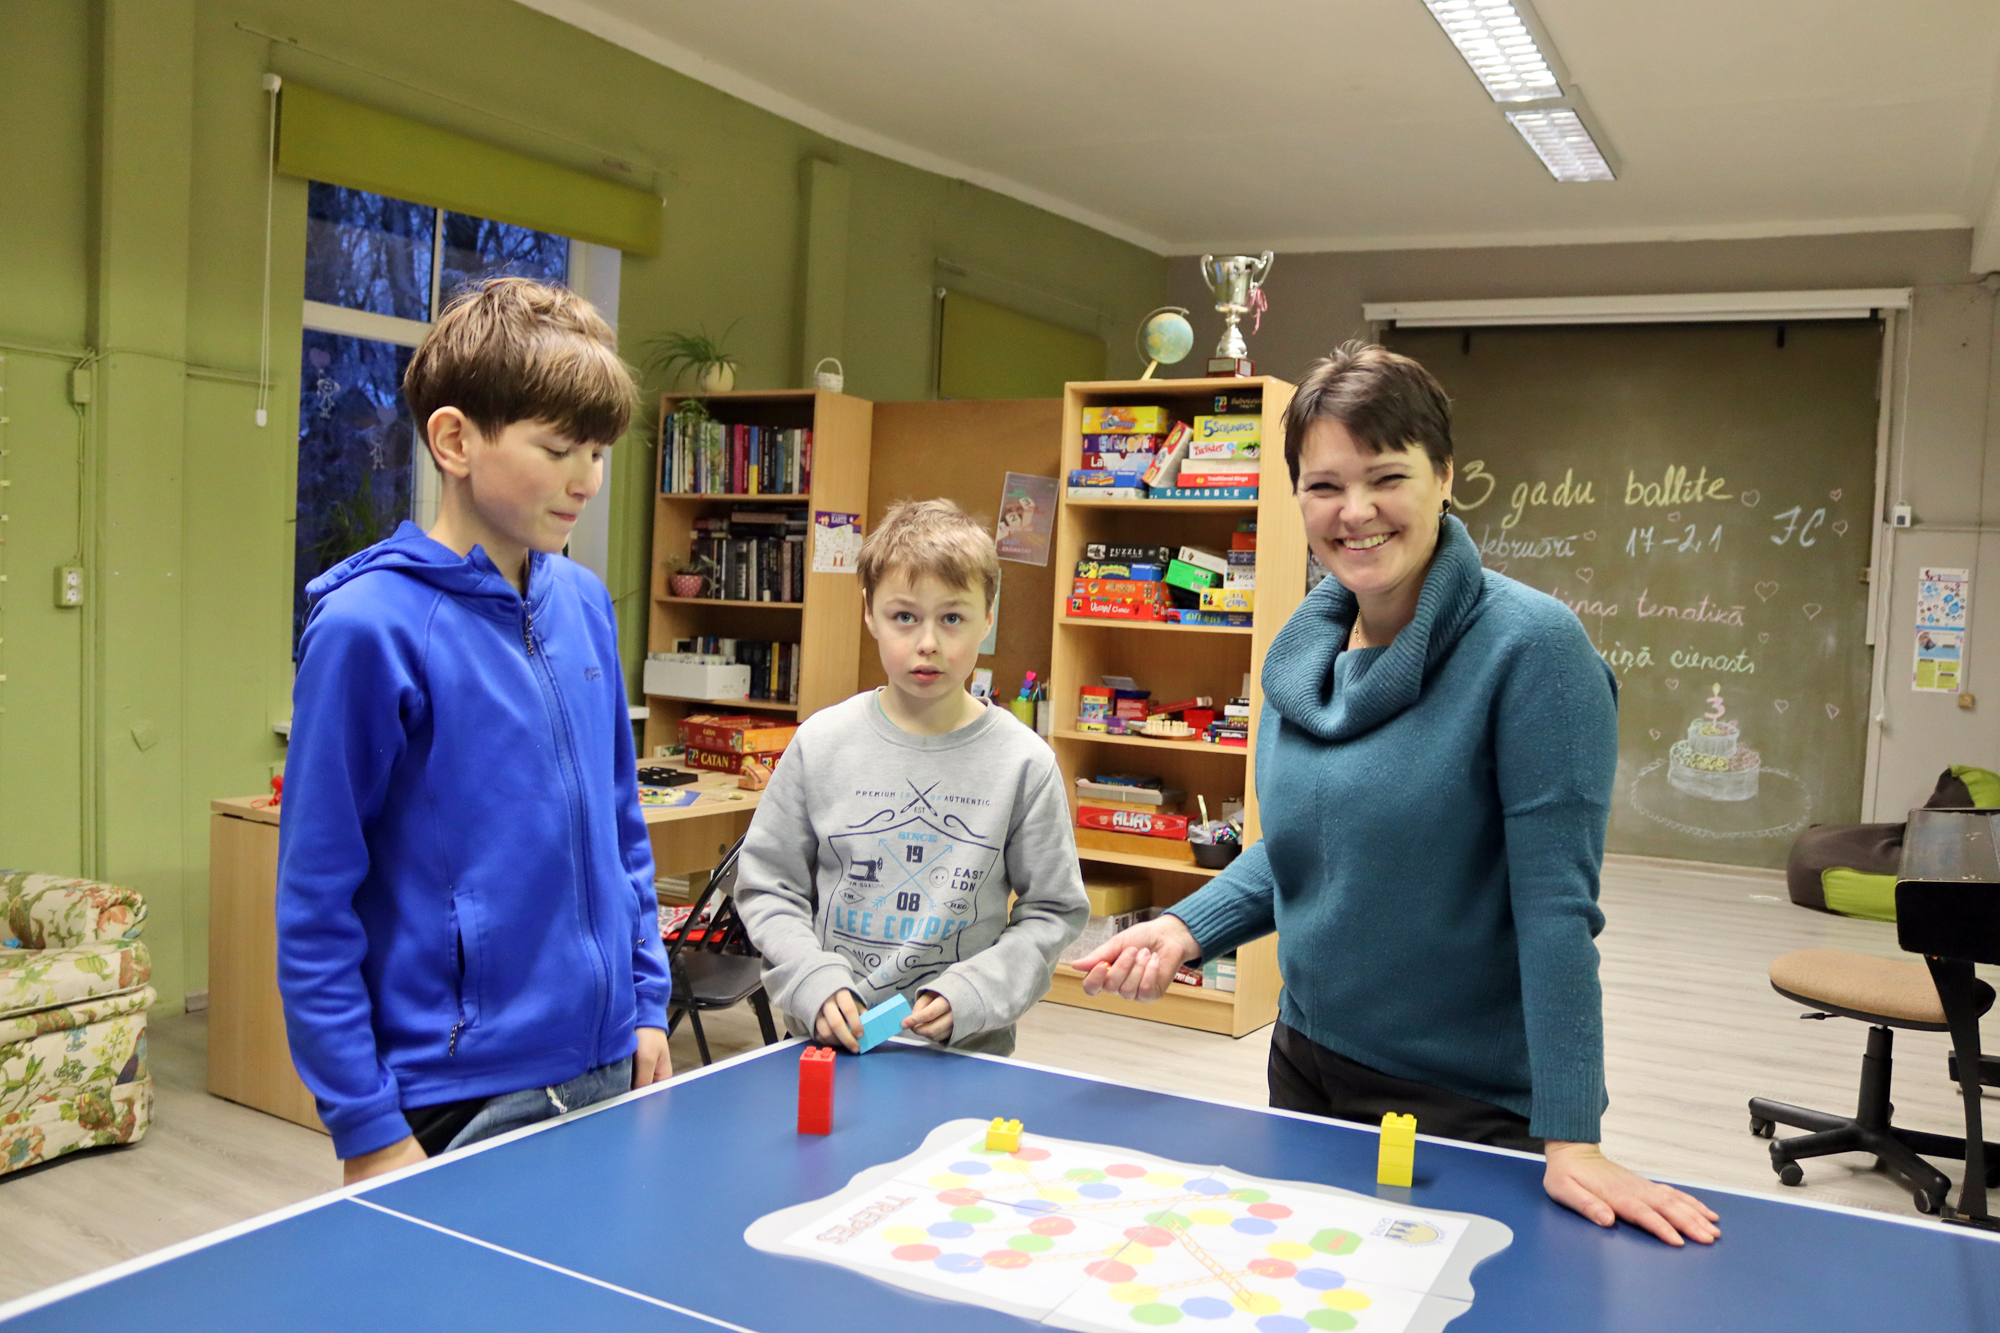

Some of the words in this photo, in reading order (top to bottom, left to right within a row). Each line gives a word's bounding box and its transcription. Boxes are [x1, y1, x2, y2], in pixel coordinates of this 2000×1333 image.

[1166, 489, 1240, 497] SCRABBLE
[1453, 460, 1496, 510] 3
[1501, 468, 1595, 529] gadu
[1110, 547, 1144, 555] PUZZLE
[1704, 696, 1727, 719] 3
[701, 753, 729, 768] CATAN
[855, 790, 896, 798] PREMIUM
[944, 795, 991, 806] AUTHENTIC
[914, 806, 926, 814] EST
[898, 831, 938, 842] SINCE
[906, 844, 923, 863] 19
[954, 867, 984, 881] EAST
[950, 879, 977, 892] LDN
[896, 891, 921, 913] 08
[836, 905, 874, 937] LEE
